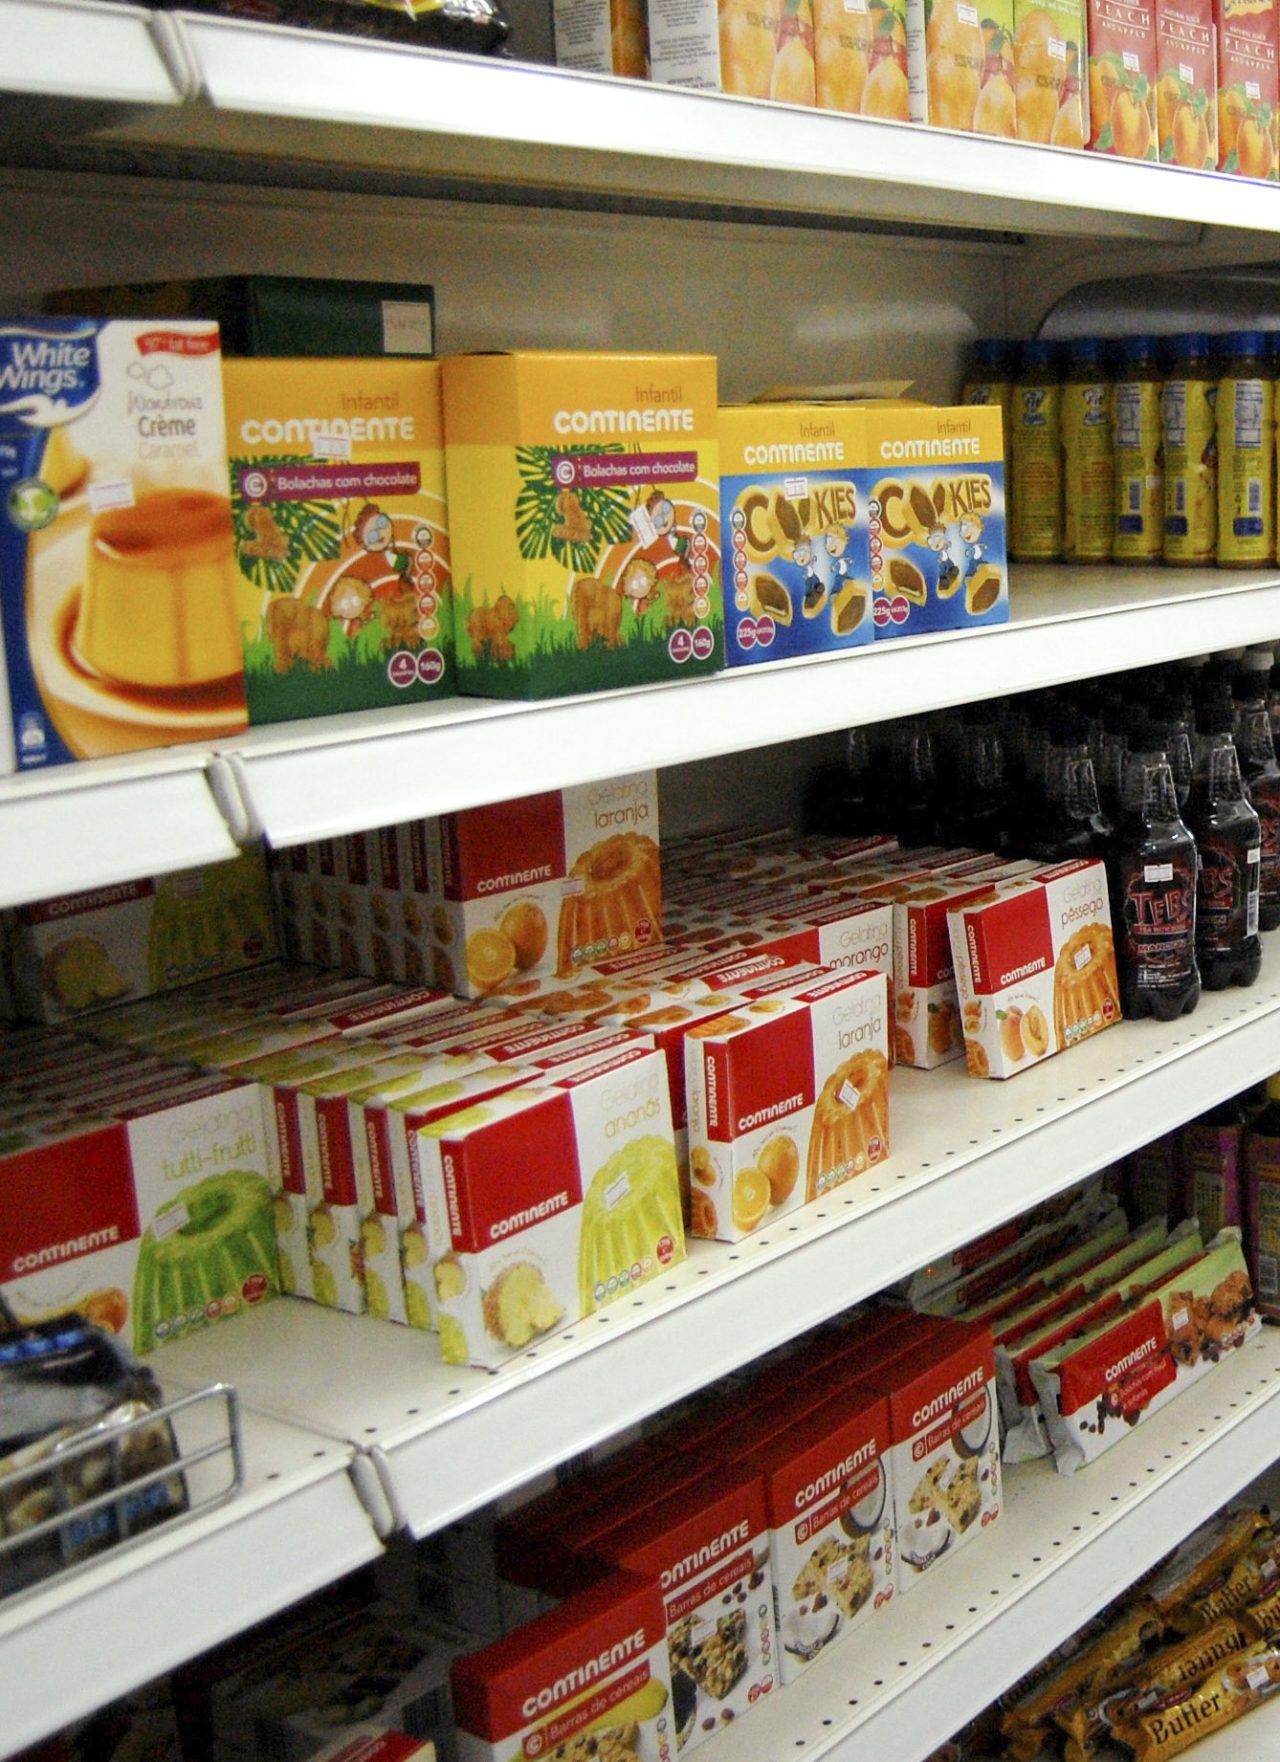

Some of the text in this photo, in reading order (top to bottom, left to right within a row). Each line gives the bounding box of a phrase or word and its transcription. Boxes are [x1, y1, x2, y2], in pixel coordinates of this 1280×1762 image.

[1095, 0, 1150, 26] PEACH
[1159, 19, 1210, 42] PEACH
[1224, 37, 1275, 59] PEACH
[12, 341, 91, 367] White
[138, 413, 196, 438] Crème
[553, 407, 694, 434] CONTINENTE
[744, 441, 845, 465] CONTINENTE
[880, 436, 981, 460] CONTINENTE
[277, 476, 333, 491] Bolachas
[335, 476, 362, 488] com
[364, 472, 418, 487] chocolate
[583, 464, 628, 478] Bolachas
[629, 464, 651, 476] com
[652, 460, 696, 474] chocolate
[594, 800, 649, 829] laranja
[477, 864, 552, 894] CONTINENTE
[48, 884, 138, 916] CONTINENTE
[1061, 896, 1104, 928] pêssego
[840, 920, 888, 948] Gelatina
[909, 918, 918, 977] CONTINENTE
[716, 956, 785, 983] CONTINENTE
[829, 942, 890, 971] morango
[967, 924, 982, 984] CONTINENTE
[1000, 956, 1047, 986] CONTINENTE
[507, 1022, 586, 1053] CONTINENTE
[552, 1032, 630, 1064] CONTINENTE
[837, 1015, 882, 1051] laranja
[706, 1055, 718, 1128] CONTINENTE
[604, 1099, 662, 1139] ananás
[738, 1092, 804, 1131] CONTINENTE
[161, 1134, 258, 1182] tutti-frutti
[276, 1101, 291, 1177] CONTINENTE
[317, 1112, 334, 1190] CONTINENTE
[366, 1121, 383, 1199] CONTINENTE
[408, 1129, 424, 1207] CONTINENTE
[443, 1154, 462, 1237] CONTINENTE
[490, 1190, 569, 1239] CONTINENTE
[12, 1225, 120, 1272] CONTINENTE
[1105, 1336, 1157, 1382] CONTINENTE
[912, 1365, 985, 1428] CONTINENTE
[927, 1427, 951, 1447] Barras
[951, 1417, 961, 1430] de
[795, 1438, 877, 1508] CONTINENTE
[812, 1508, 839, 1529] Barras
[839, 1494, 851, 1510] de
[852, 1475, 880, 1500] cereais
[660, 1519, 749, 1588] ONTINENTE
[668, 1558, 753, 1618] Barras de cereais
[1200, 1573, 1255, 1624] Butter
[522, 1626, 646, 1718] CONTINENTE
[549, 1706, 590, 1740] Barras
[590, 1694, 607, 1713] de
[608, 1669, 649, 1703] cereais
[1148, 1692, 1222, 1746] Butter
